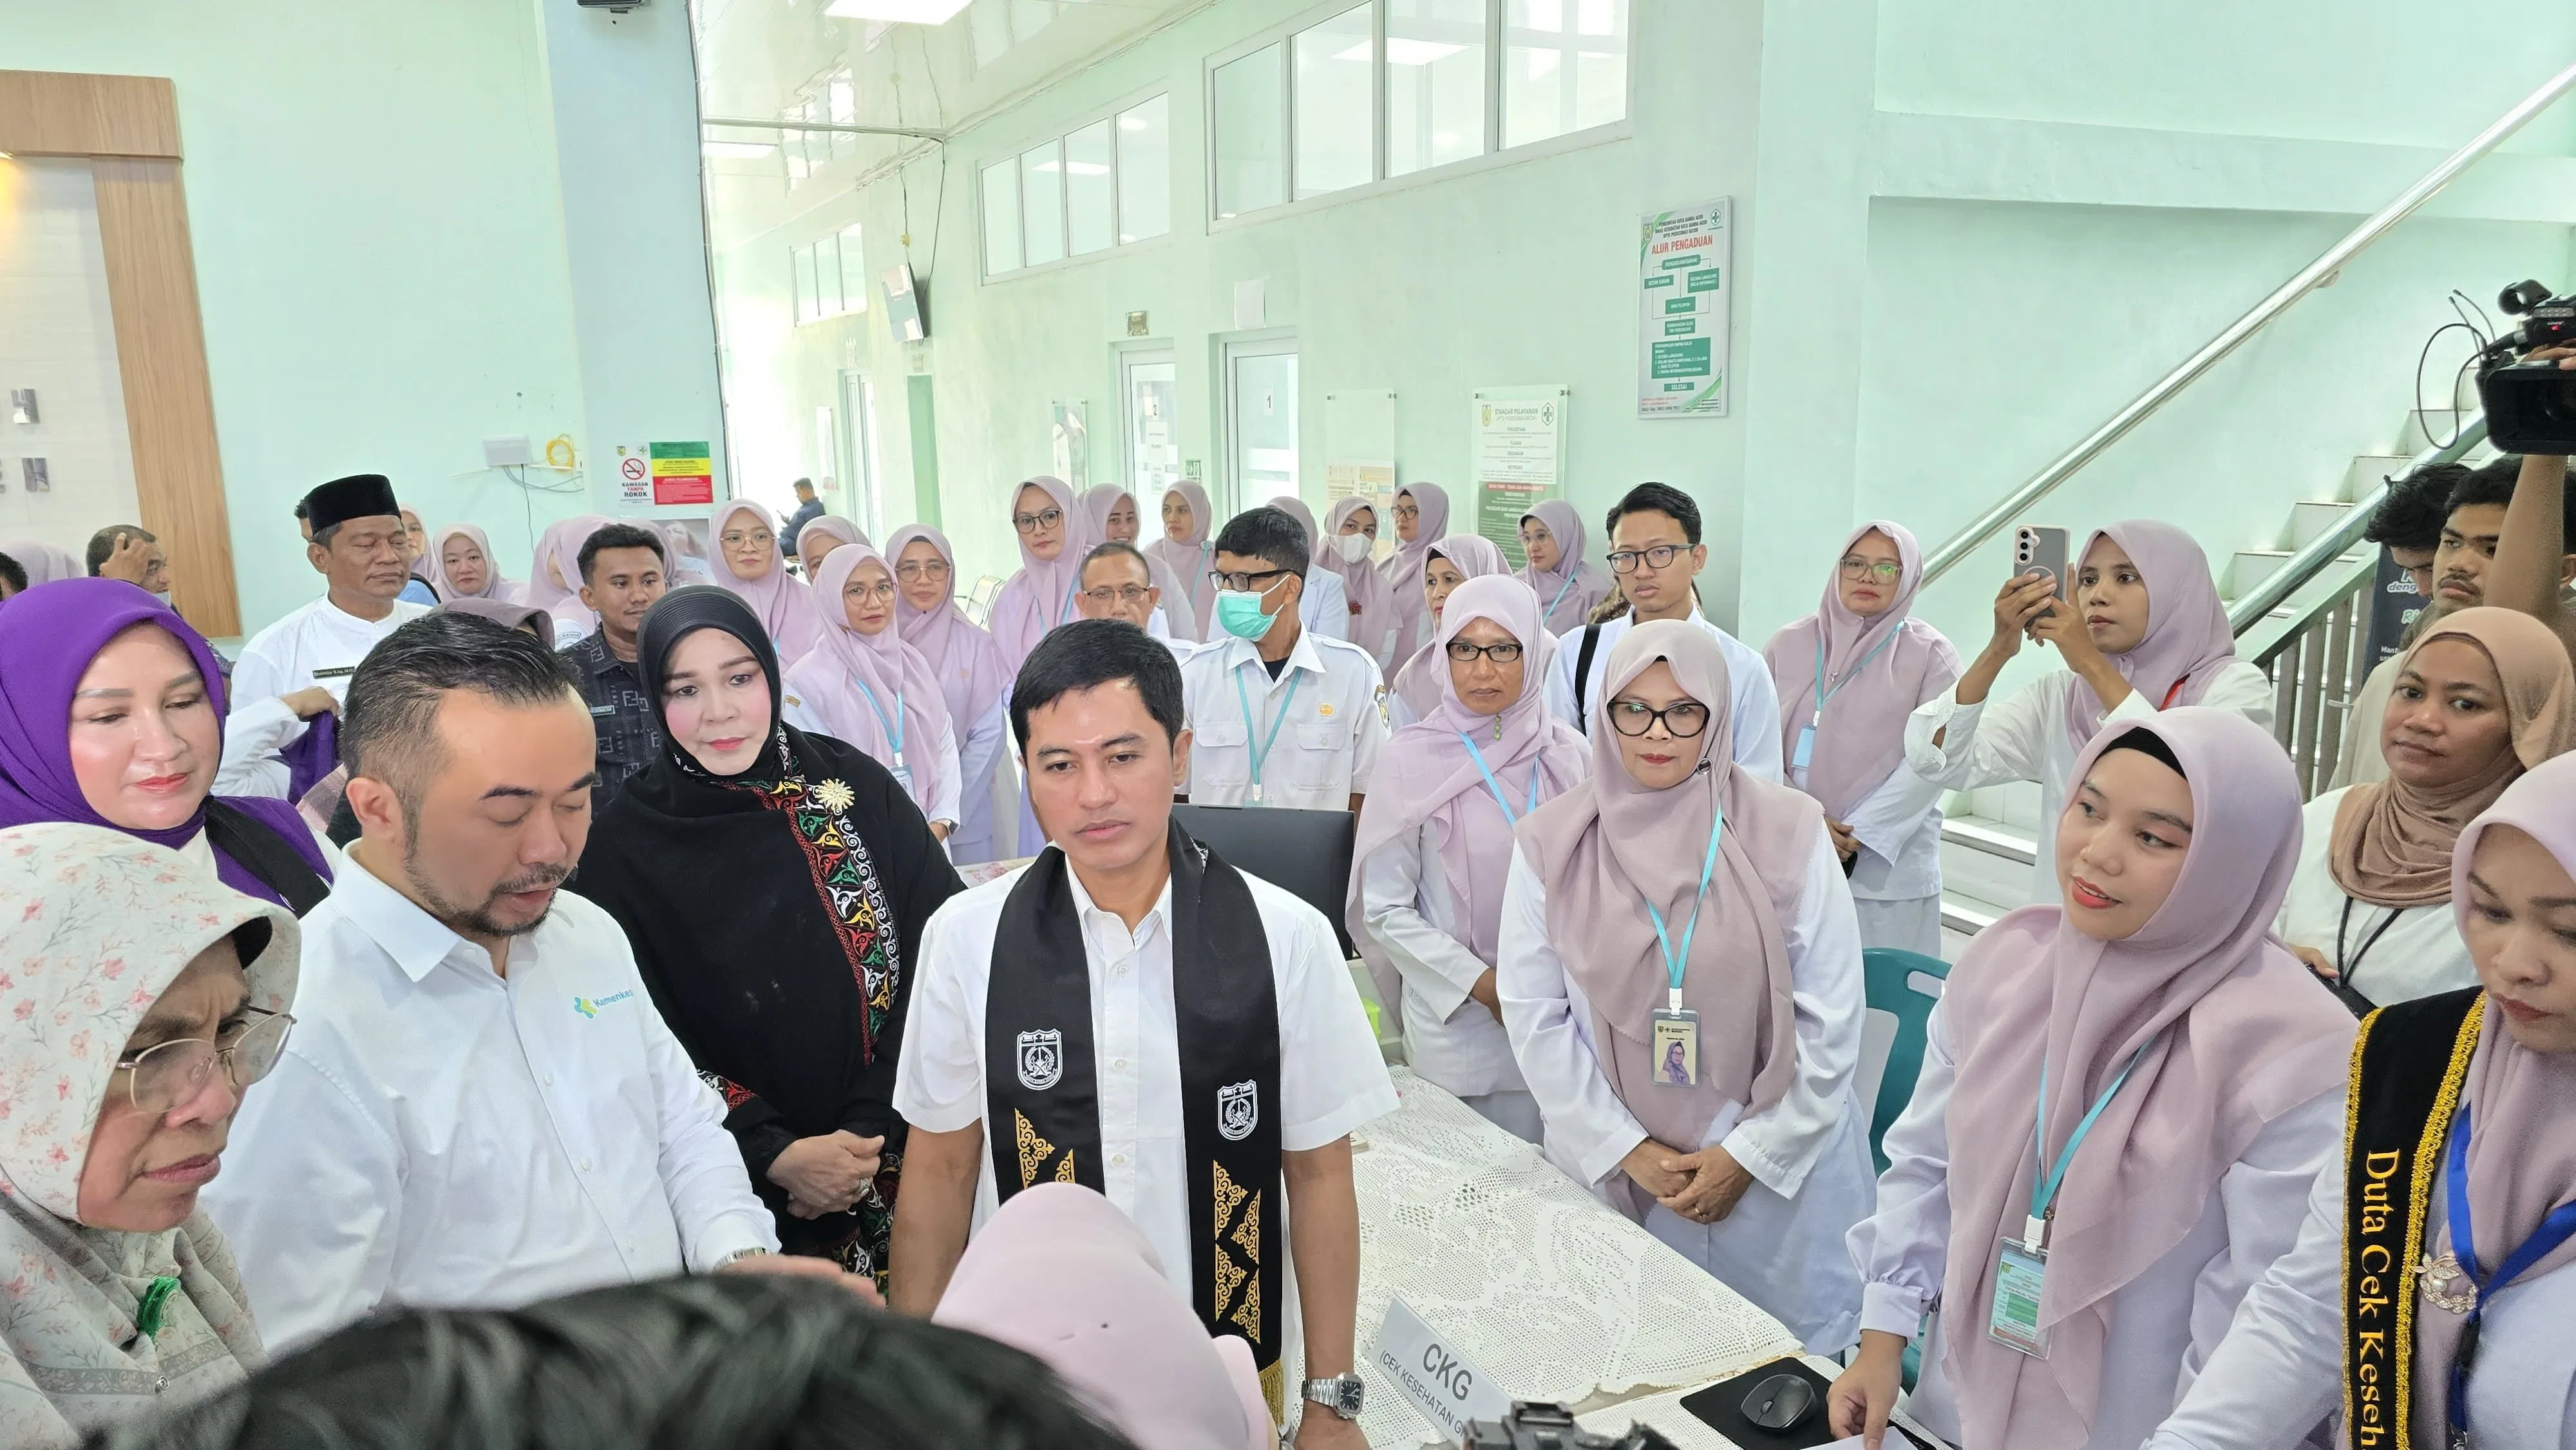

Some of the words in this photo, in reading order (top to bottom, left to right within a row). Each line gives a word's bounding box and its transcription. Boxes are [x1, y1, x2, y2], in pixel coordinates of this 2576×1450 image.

[1651, 242, 1669, 255] ALUR
[1671, 234, 1713, 252] PENGADUAN
[1153, 404, 1157, 416] 2
[1267, 394, 1271, 409] 1
[2361, 1148, 2400, 1236] Duta
[2358, 1244, 2391, 1320] Cek
[1379, 1350, 1402, 1376] (CEK
[1400, 1372, 1455, 1427] KESEHATAN
[1423, 1343, 1473, 1401] CKG
[2358, 1329, 2385, 1450] Keseh
